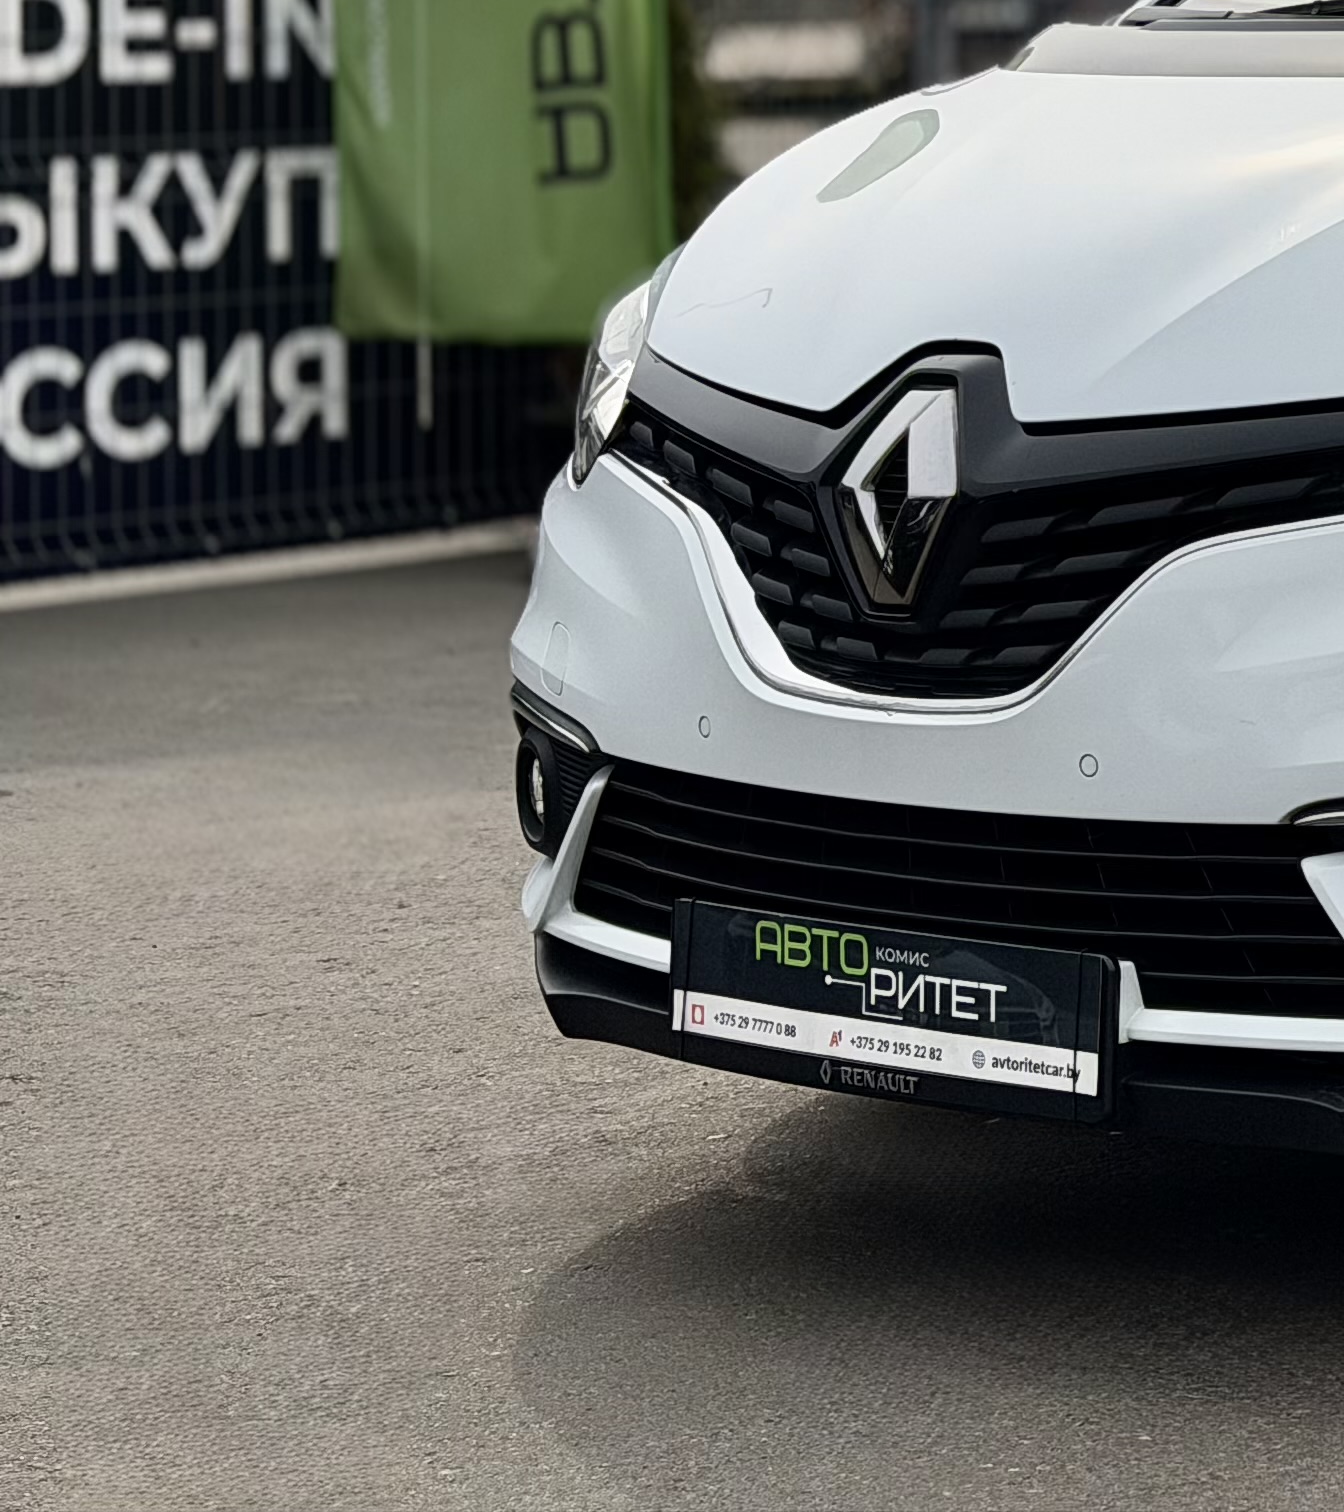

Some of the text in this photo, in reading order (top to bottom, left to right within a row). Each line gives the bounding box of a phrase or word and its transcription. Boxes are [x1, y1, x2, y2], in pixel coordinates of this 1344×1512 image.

[755, 920, 869, 976] АВТО
[870, 967, 1008, 1023] РИТЕТ
[713, 1012, 737, 1028] +375
[849, 1035, 943, 1062] +375 29 195 22 82
[840, 1065, 919, 1094] RENAULT
